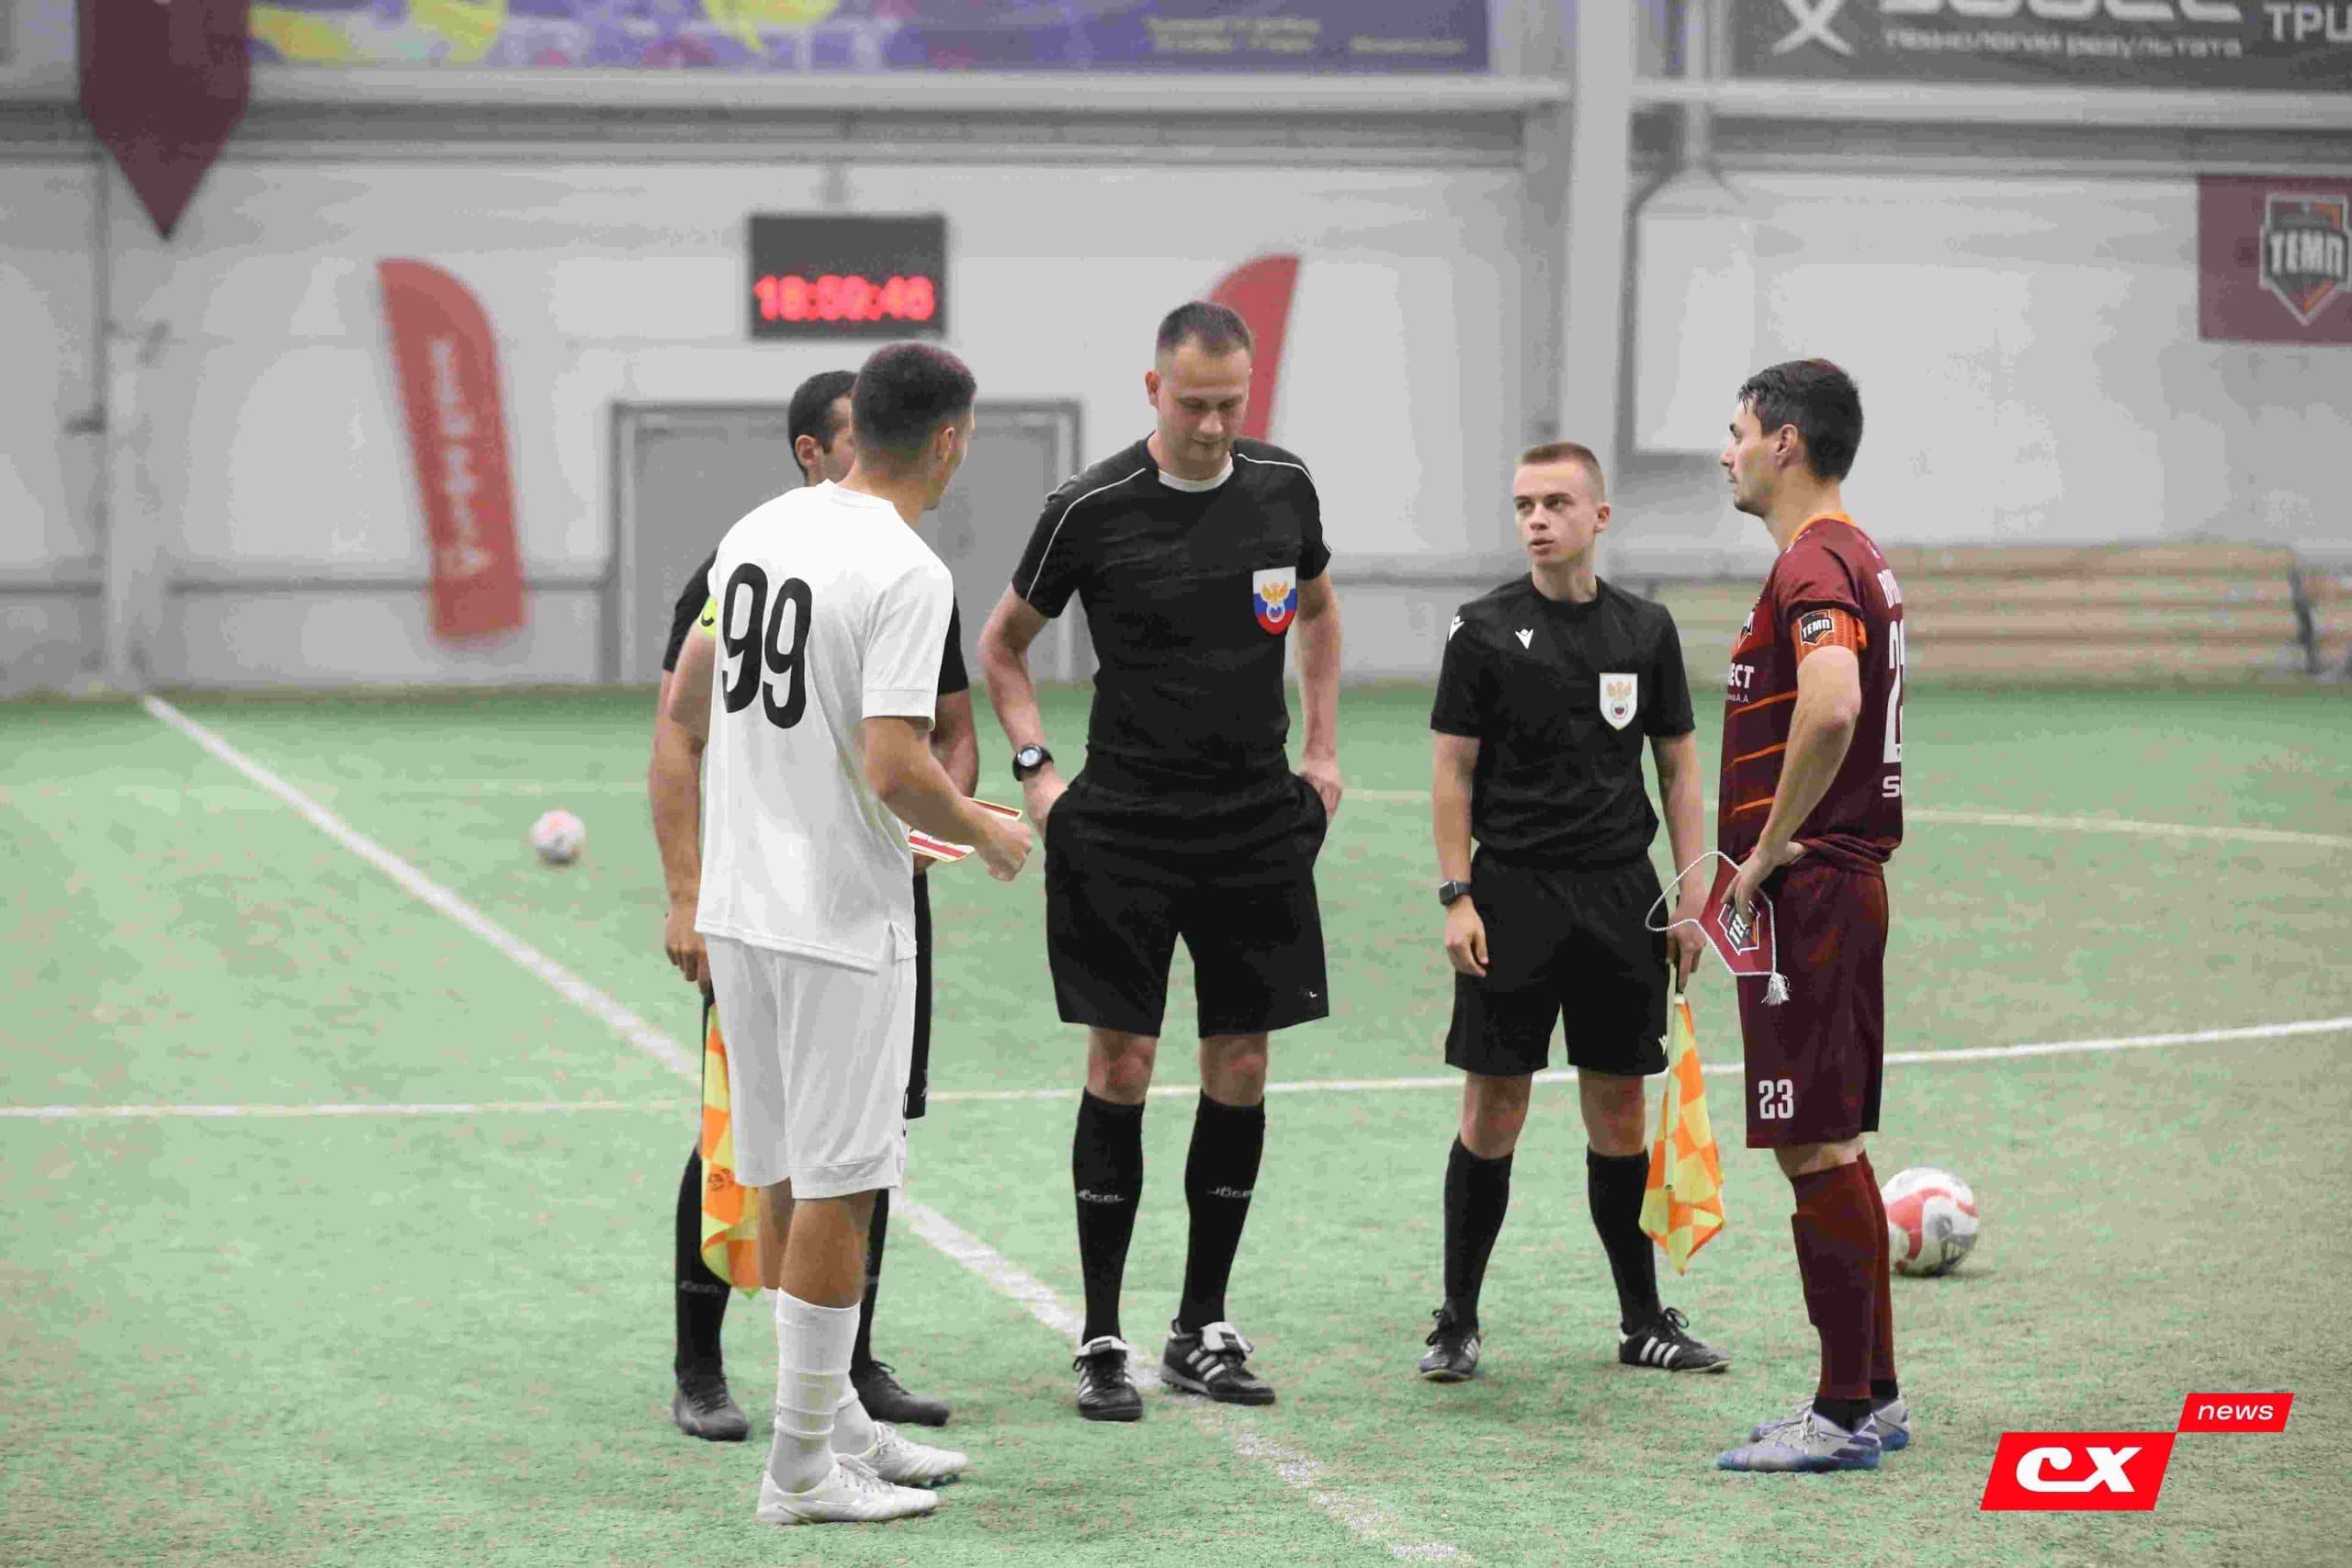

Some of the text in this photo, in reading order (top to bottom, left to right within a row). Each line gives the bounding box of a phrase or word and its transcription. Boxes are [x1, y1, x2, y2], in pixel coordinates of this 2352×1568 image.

[2270, 231, 2344, 276] ТЕМП
[722, 563, 812, 729] 99
[1802, 618, 1831, 638] ТЕМП
[1883, 620, 1905, 763] 2
[1758, 1079, 1794, 1120] 23
